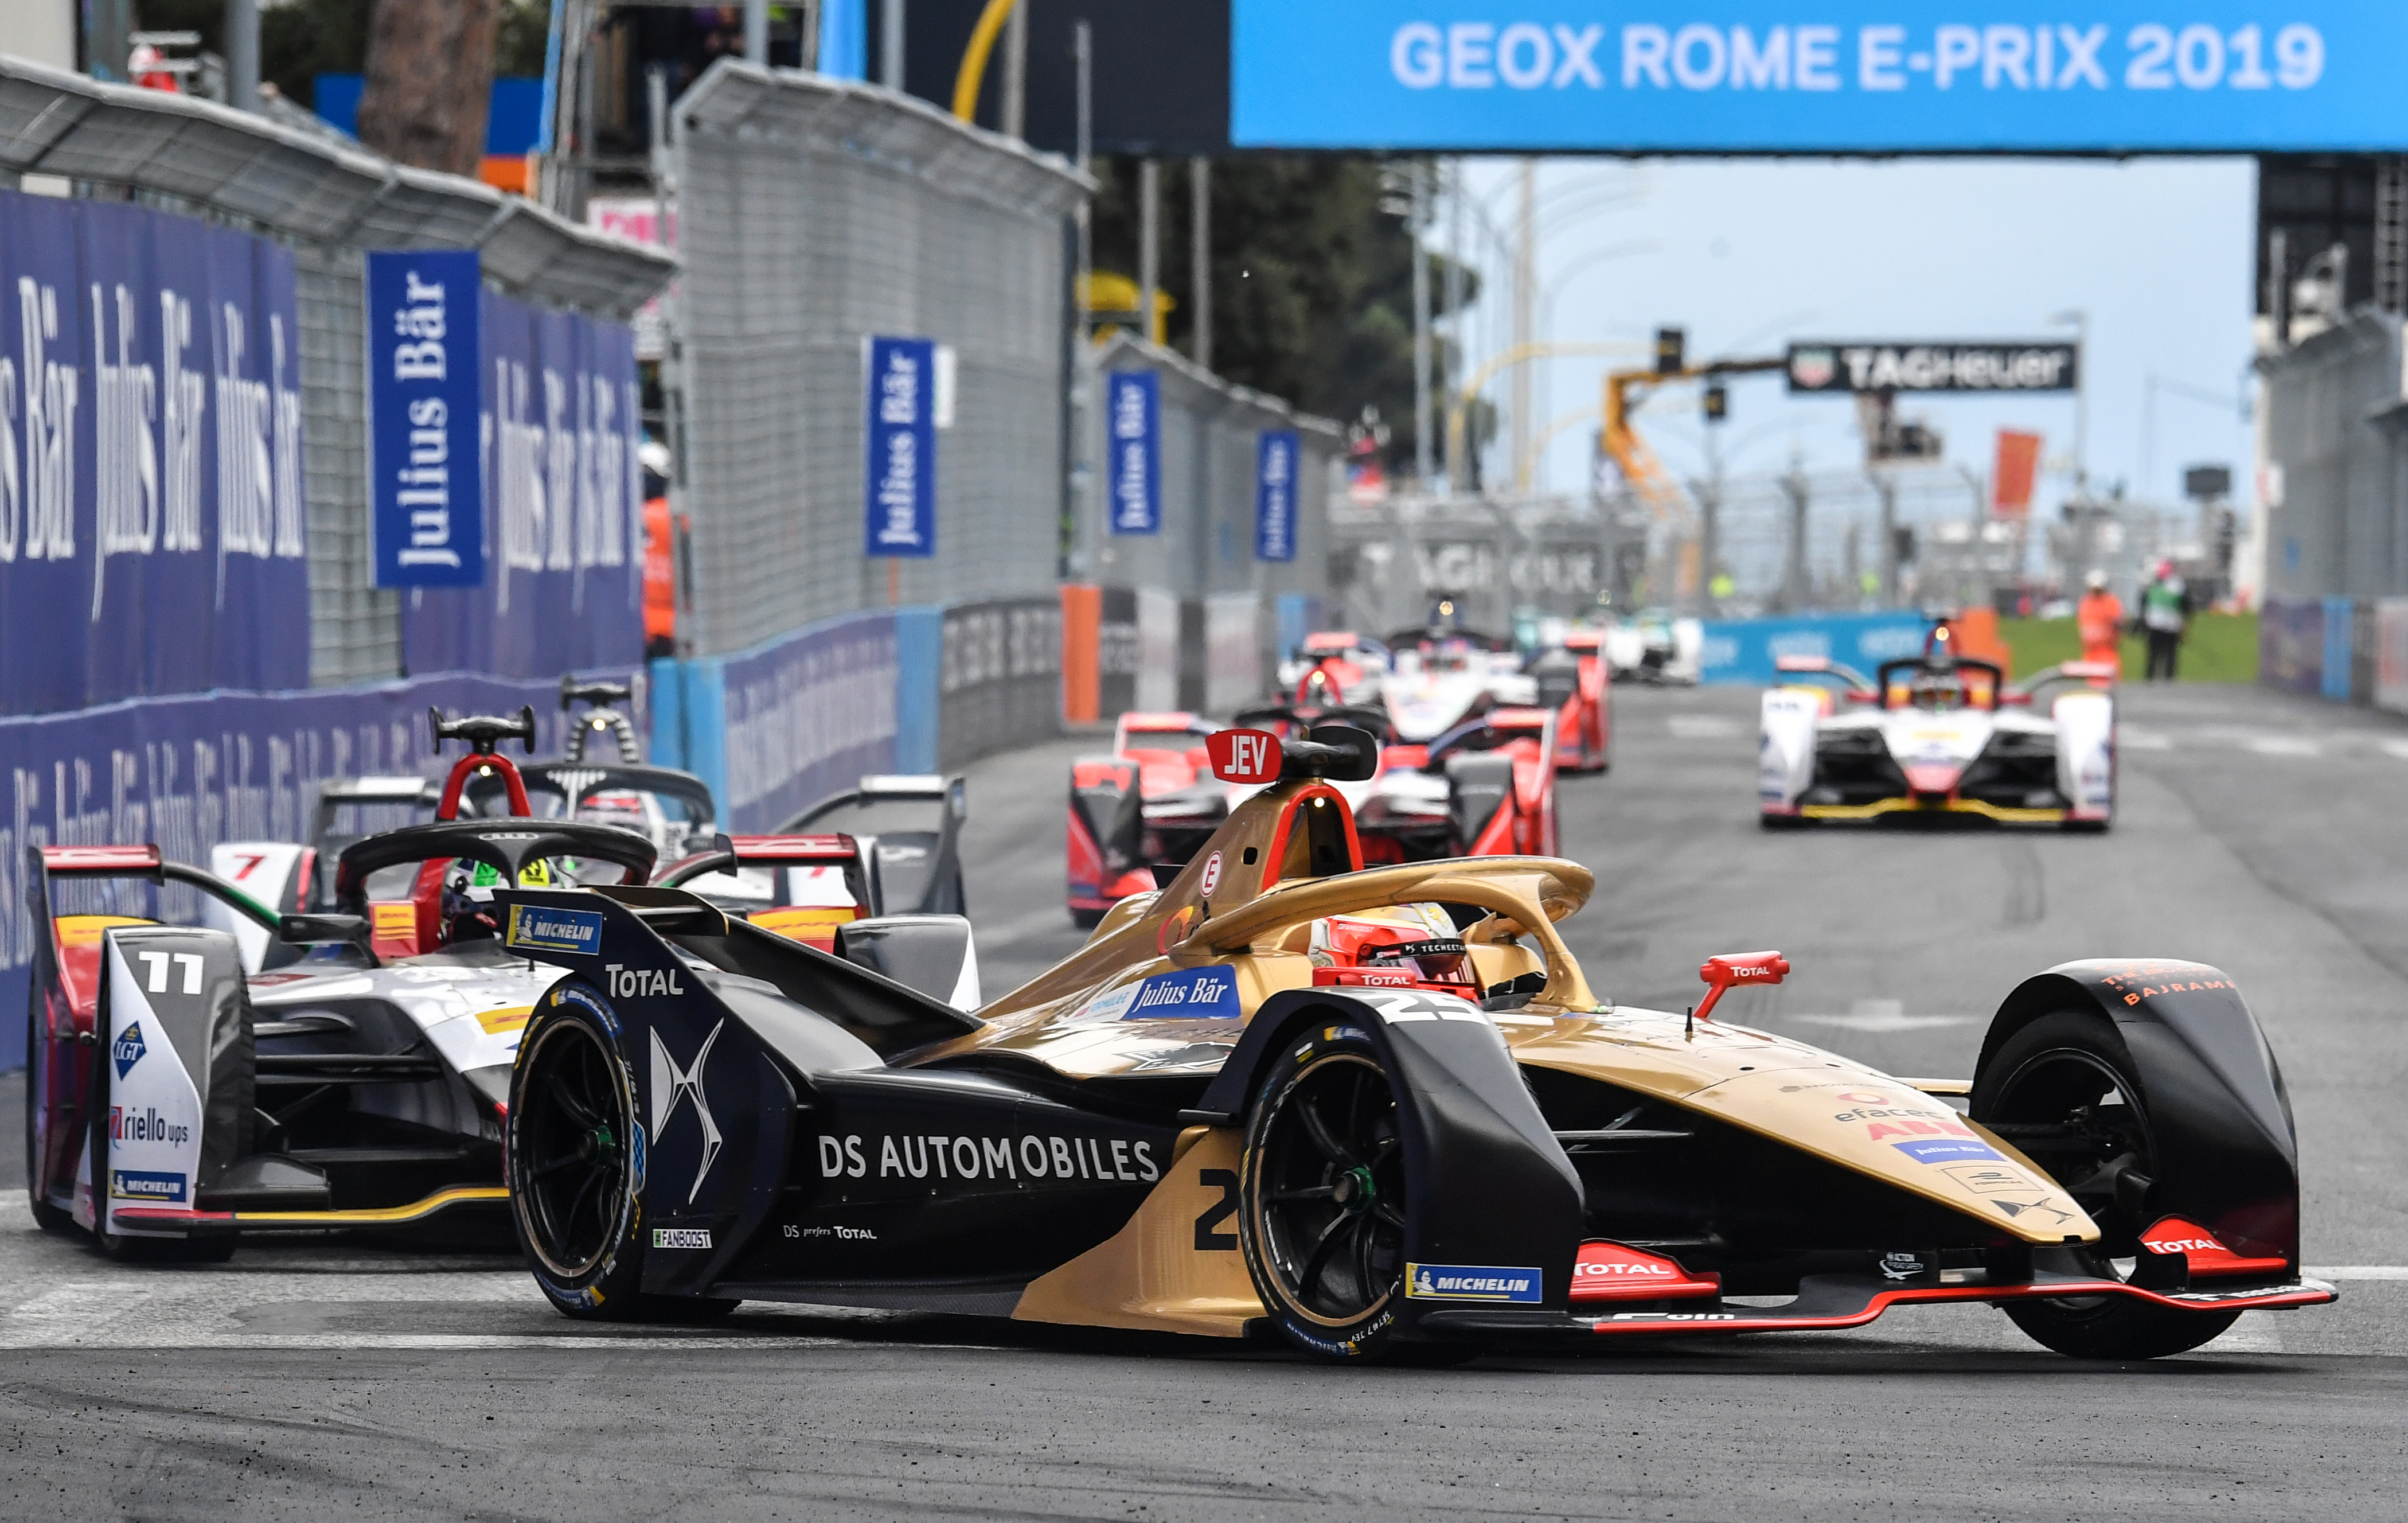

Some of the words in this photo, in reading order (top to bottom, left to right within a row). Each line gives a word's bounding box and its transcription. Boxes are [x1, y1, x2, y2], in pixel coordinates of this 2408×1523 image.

[1390, 21, 1605, 91] GEOX
[1620, 23, 1841, 91] ROME
[1857, 24, 2109, 91] E-PRIX
[2124, 24, 2326, 89] 2019
[395, 270, 447, 383] Bär
[868, 346, 919, 424] Bär
[397, 396, 460, 569] Julius
[867, 430, 923, 545] Julius
[1224, 735, 1267, 776] JEV
[234, 854, 267, 881] 7
[534, 922, 594, 941] MICHELIN
[139, 951, 204, 995] 11
[1131, 980, 1188, 1013] Julius
[1188, 977, 1228, 1004] Bär
[1359, 994, 1489, 1025] 25
[115, 1041, 143, 1061] LGT
[124, 1107, 165, 1141] riello
[168, 1124, 188, 1148] ups
[818, 1135, 867, 1178] DS
[880, 1135, 1160, 1181] AUTOMOBILES
[127, 1179, 181, 1194] MICHELIN
[663, 1231, 709, 1247] FANBOOST
[783, 1225, 799, 1237] DS
[803, 1228, 831, 1237] prefers
[1437, 1277, 1530, 1292] MICHELIN
